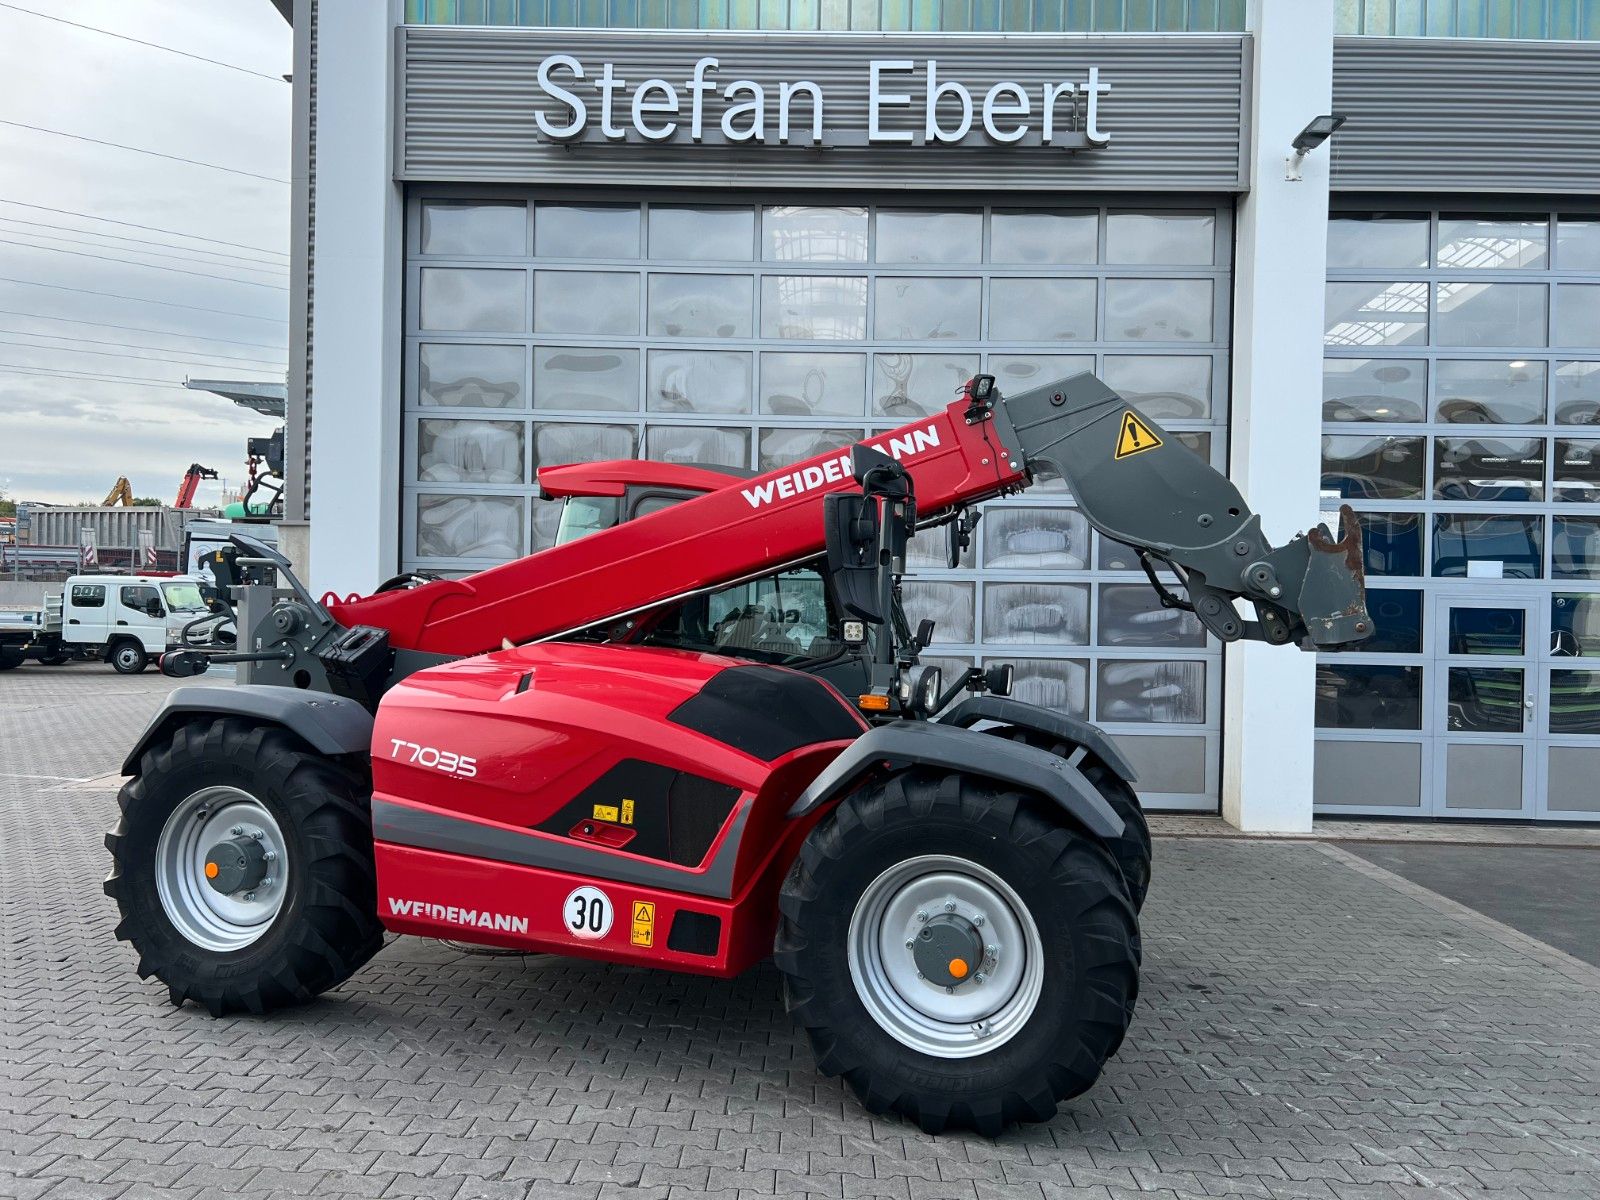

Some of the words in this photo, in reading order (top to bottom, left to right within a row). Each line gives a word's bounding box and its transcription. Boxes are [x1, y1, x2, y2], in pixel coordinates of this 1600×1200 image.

[534, 54, 824, 144] Stefan
[868, 59, 1112, 144] Ebert
[390, 738, 477, 777] T7035
[388, 897, 529, 934] WEIDEMANN
[571, 895, 604, 932] 30
